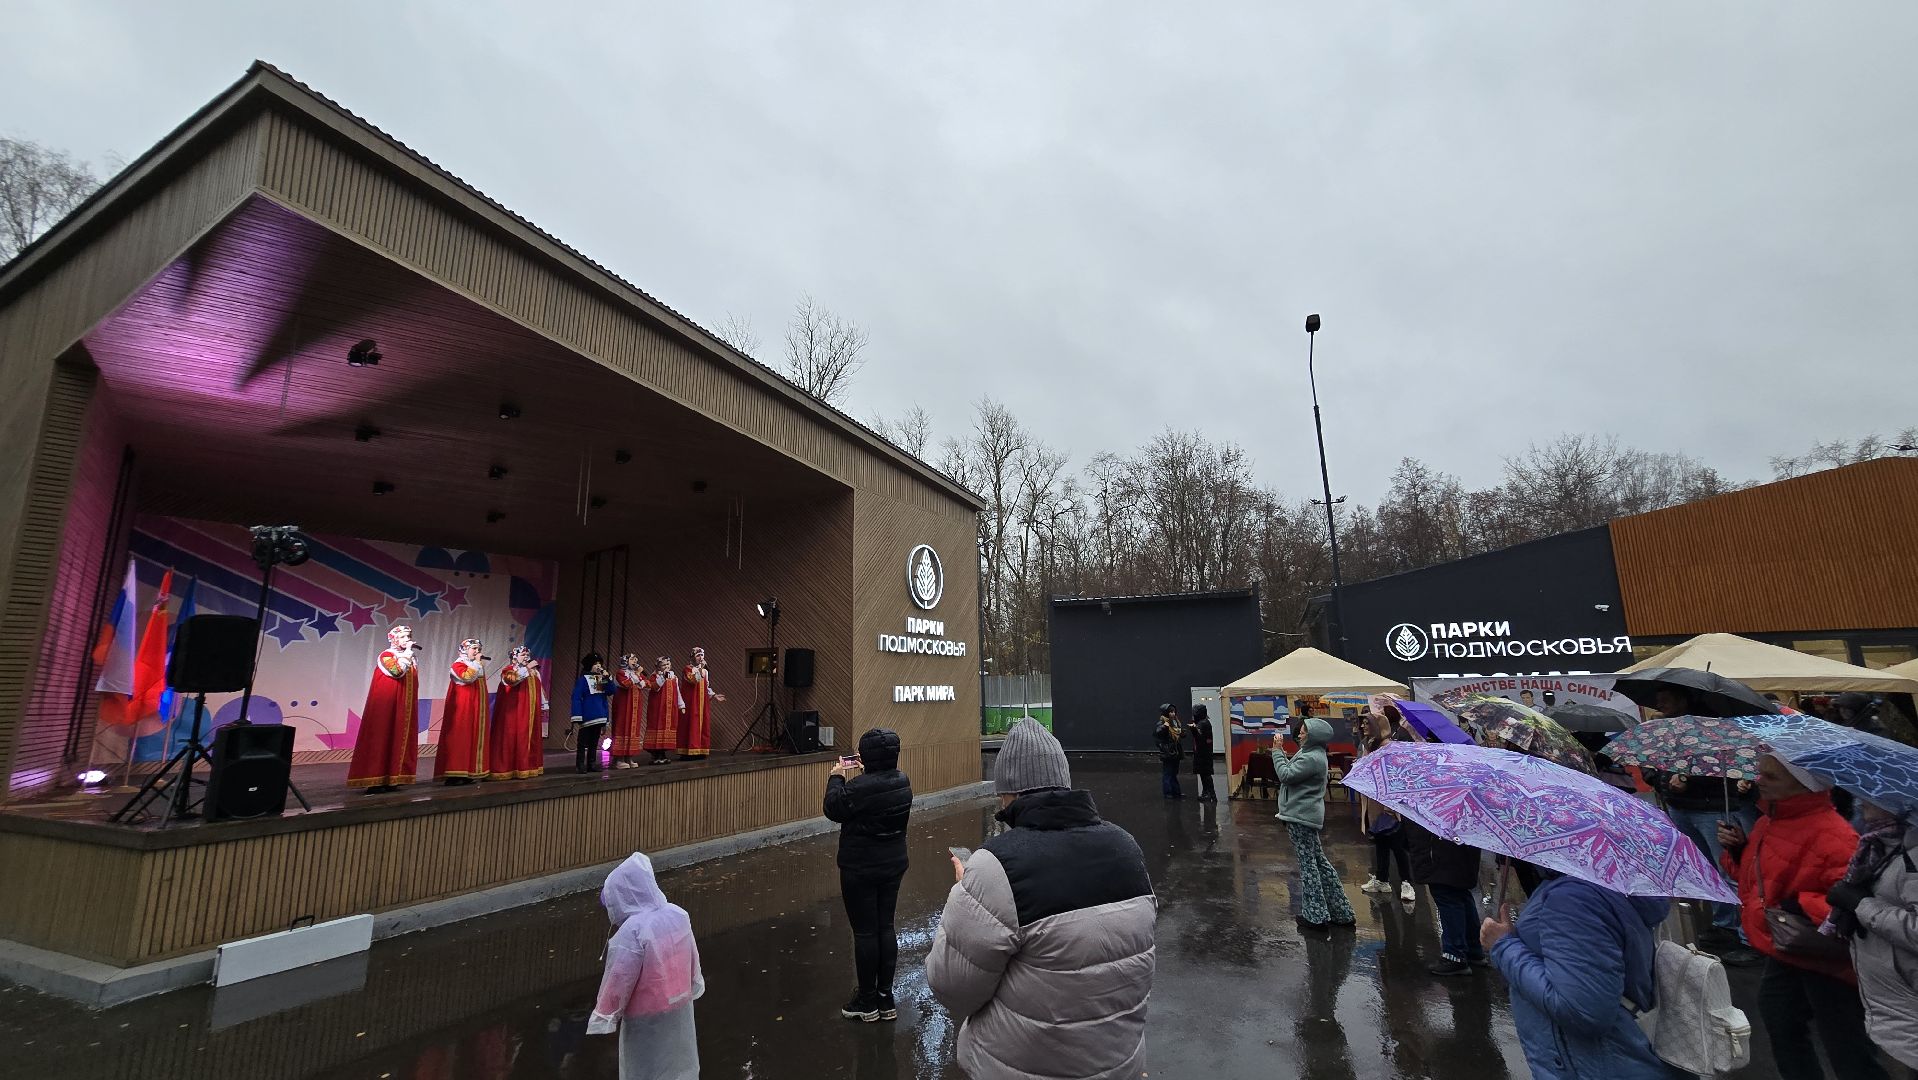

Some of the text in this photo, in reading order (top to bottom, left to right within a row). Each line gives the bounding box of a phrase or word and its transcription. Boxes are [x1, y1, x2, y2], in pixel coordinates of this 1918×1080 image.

[906, 616, 944, 636] ПАРКИ
[1430, 620, 1511, 640] ПАРКИ
[878, 633, 966, 657] ПОДМОСКОВЬЯ
[1432, 635, 1633, 659] ПОДМОСКОВЬЯ
[894, 684, 956, 702] ПАРК МИРА
[1520, 679, 1563, 692] НАША
